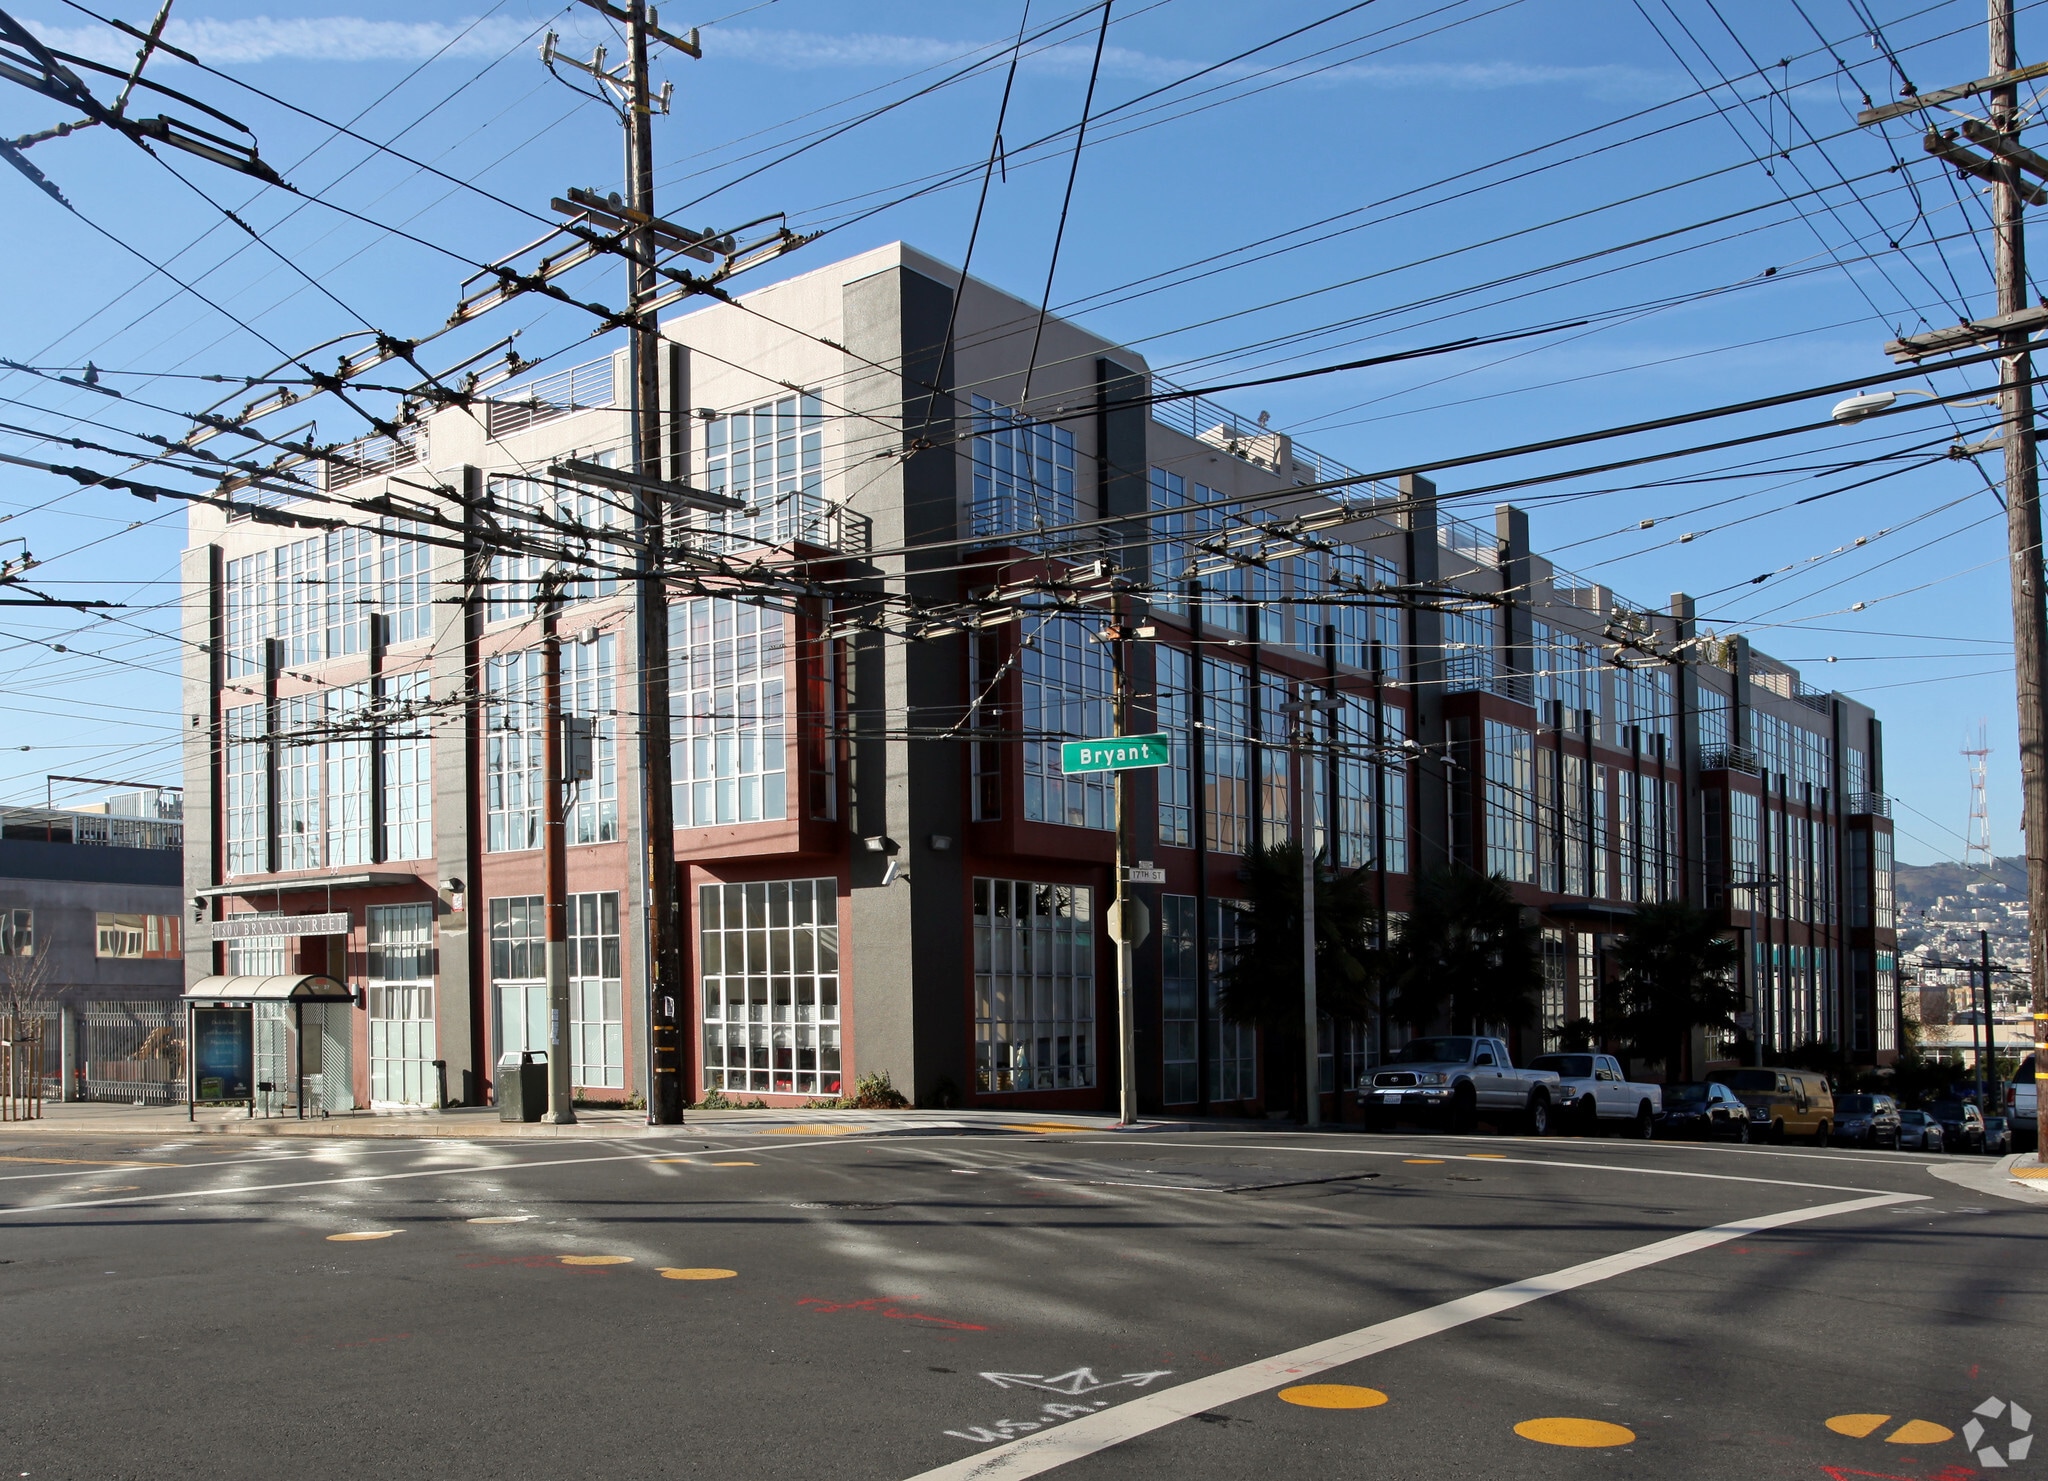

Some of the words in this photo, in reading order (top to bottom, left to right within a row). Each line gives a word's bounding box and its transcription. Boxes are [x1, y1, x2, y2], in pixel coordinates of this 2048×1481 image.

[1080, 744, 1149, 766] Bryant
[1133, 870, 1149, 879] 17TH
[1152, 871, 1162, 880] ST
[244, 920, 291, 936] BRYANT
[296, 917, 344, 932] STREET
